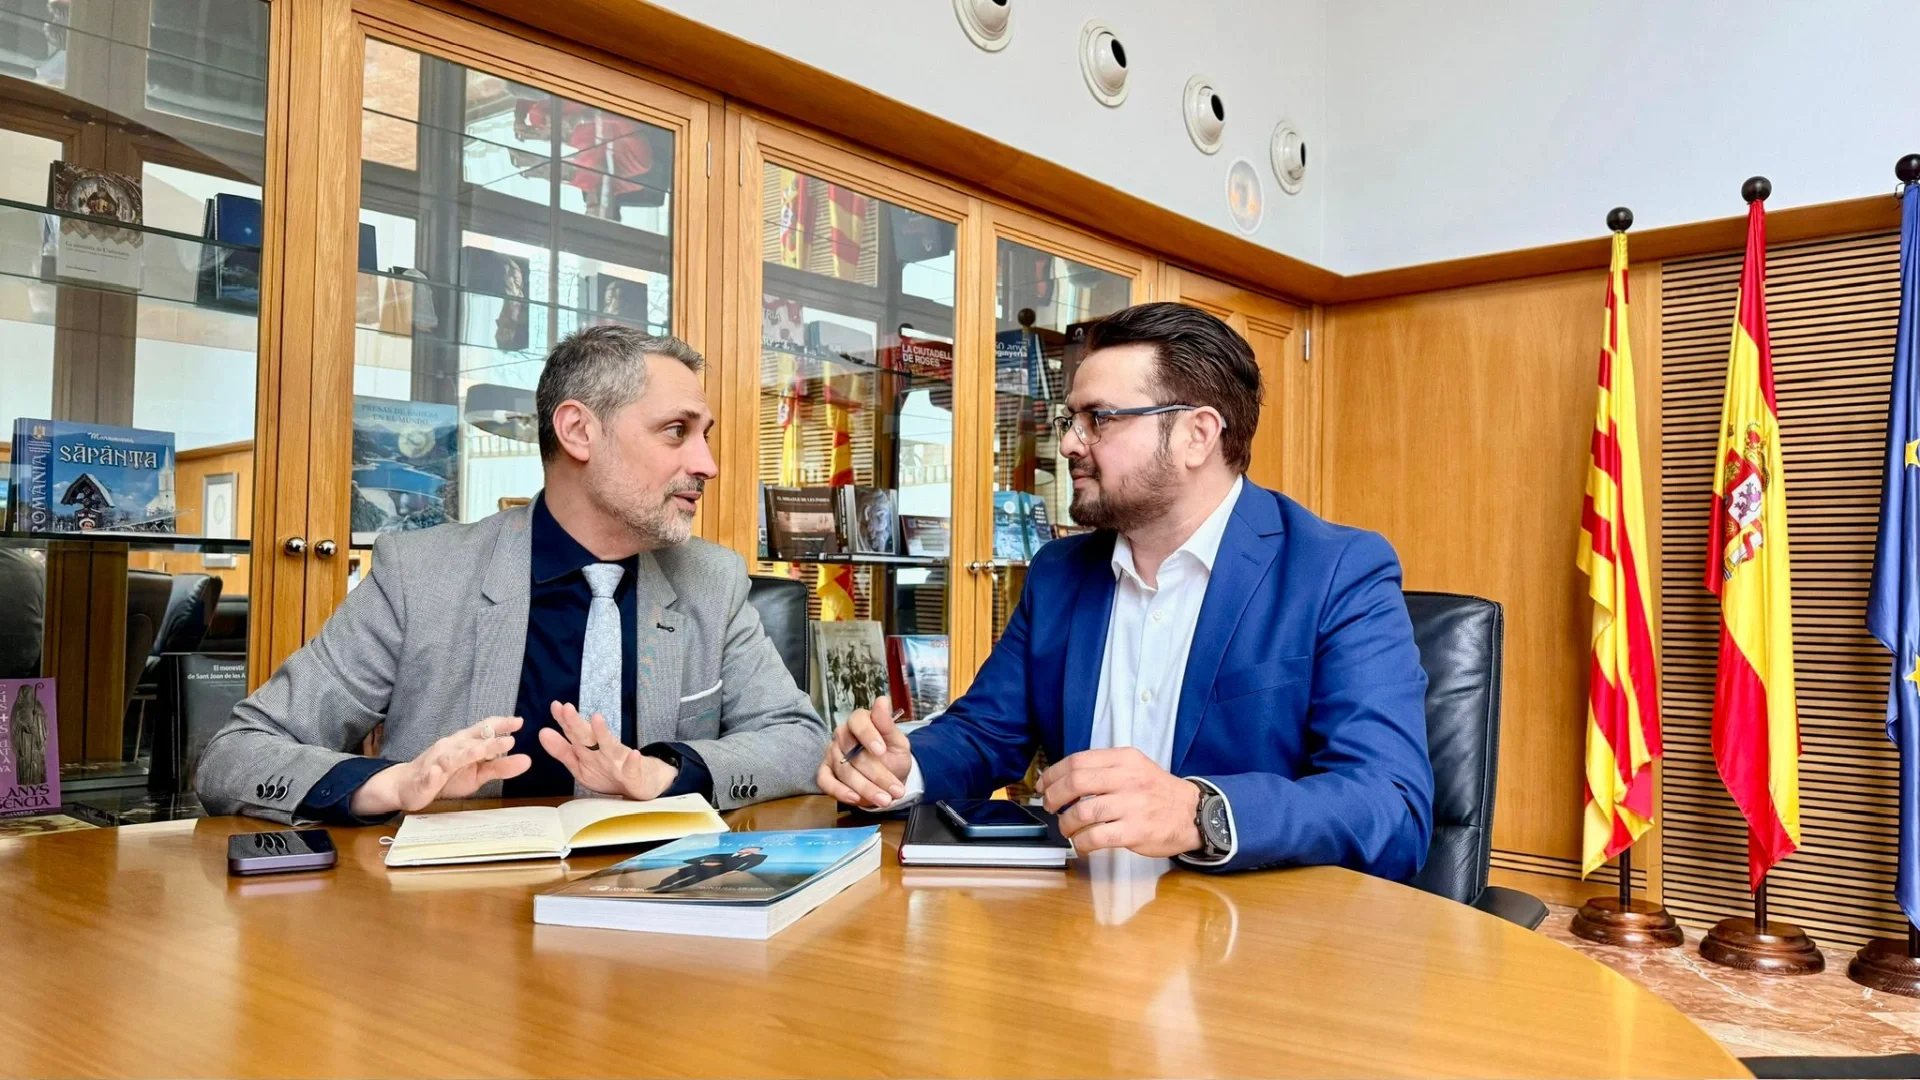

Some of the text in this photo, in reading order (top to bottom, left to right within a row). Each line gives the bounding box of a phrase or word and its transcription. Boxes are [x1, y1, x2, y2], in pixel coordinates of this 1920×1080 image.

[902, 344, 912, 354] LA
[902, 353, 940, 367] DE ROSES
[6, 784, 50, 798] ANYS
